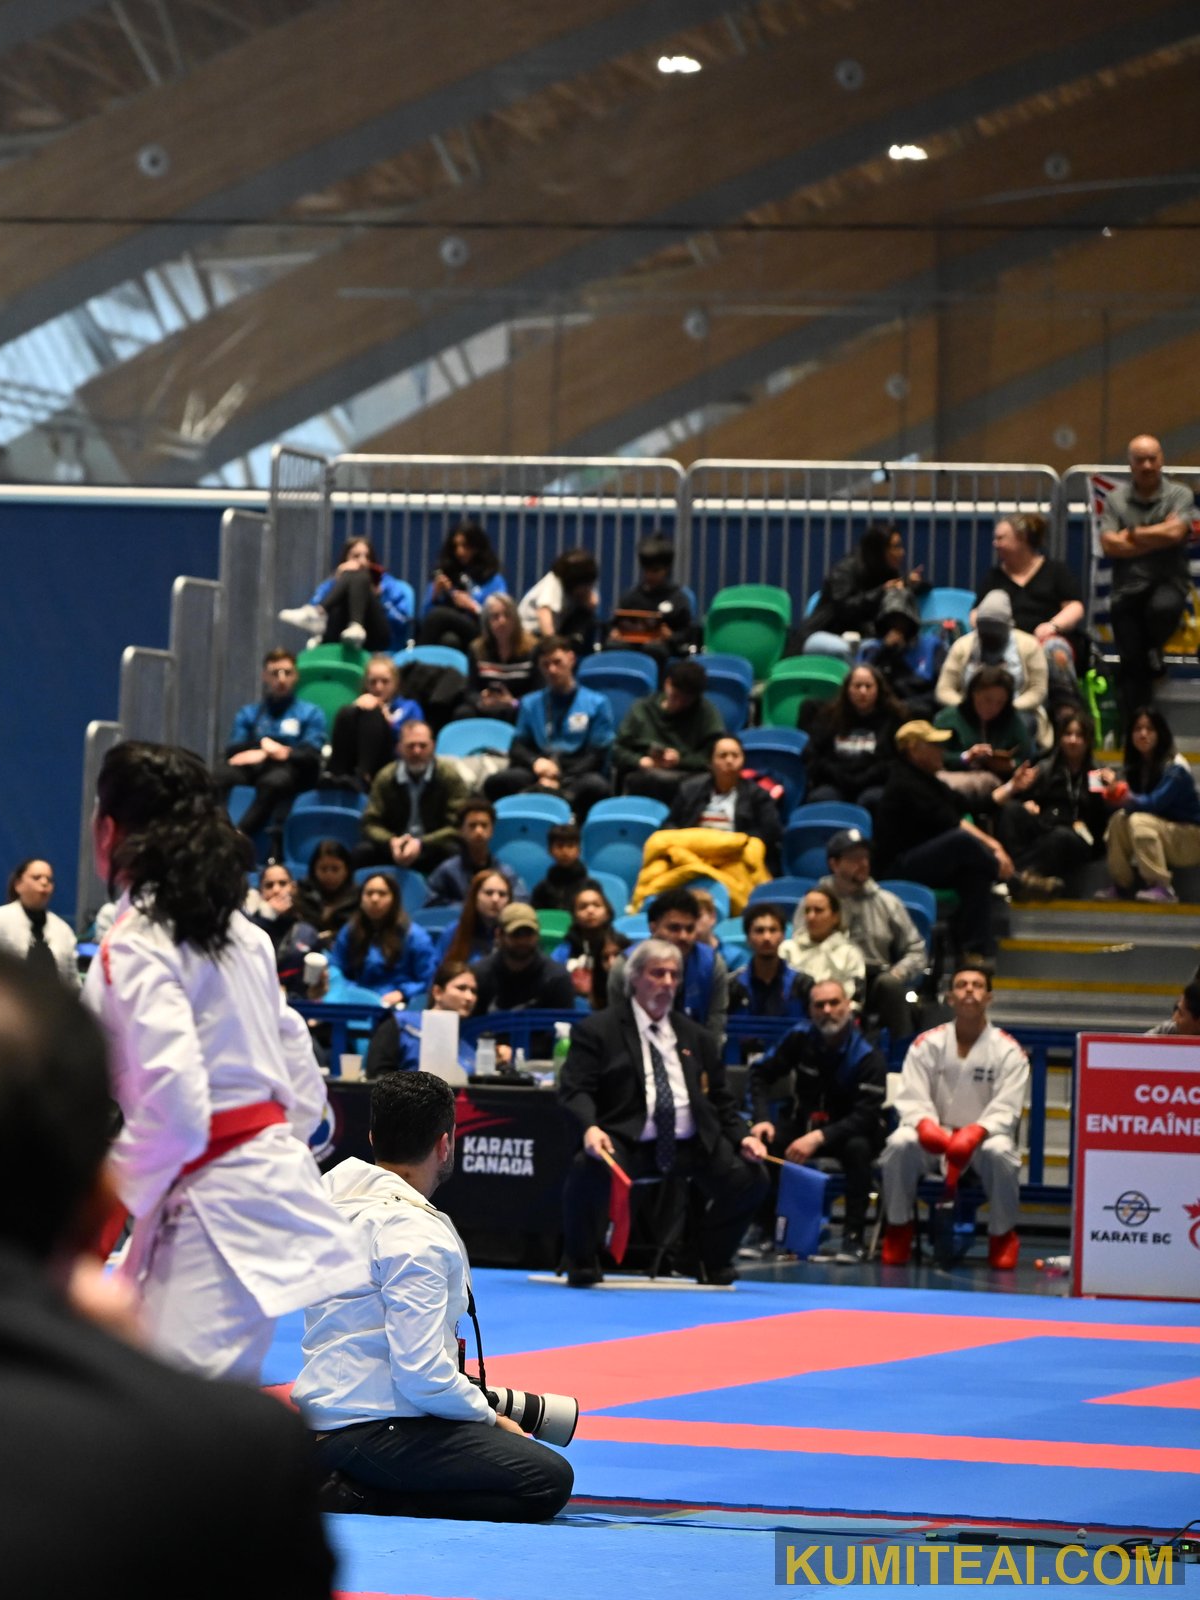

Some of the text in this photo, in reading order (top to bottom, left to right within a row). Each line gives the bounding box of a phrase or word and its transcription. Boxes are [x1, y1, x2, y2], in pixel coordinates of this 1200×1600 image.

[1134, 1084, 1200, 1105] COAC
[463, 1136, 535, 1158] KARATE
[462, 1156, 535, 1176] CANADA
[1090, 1230, 1172, 1245] KARATE BC
